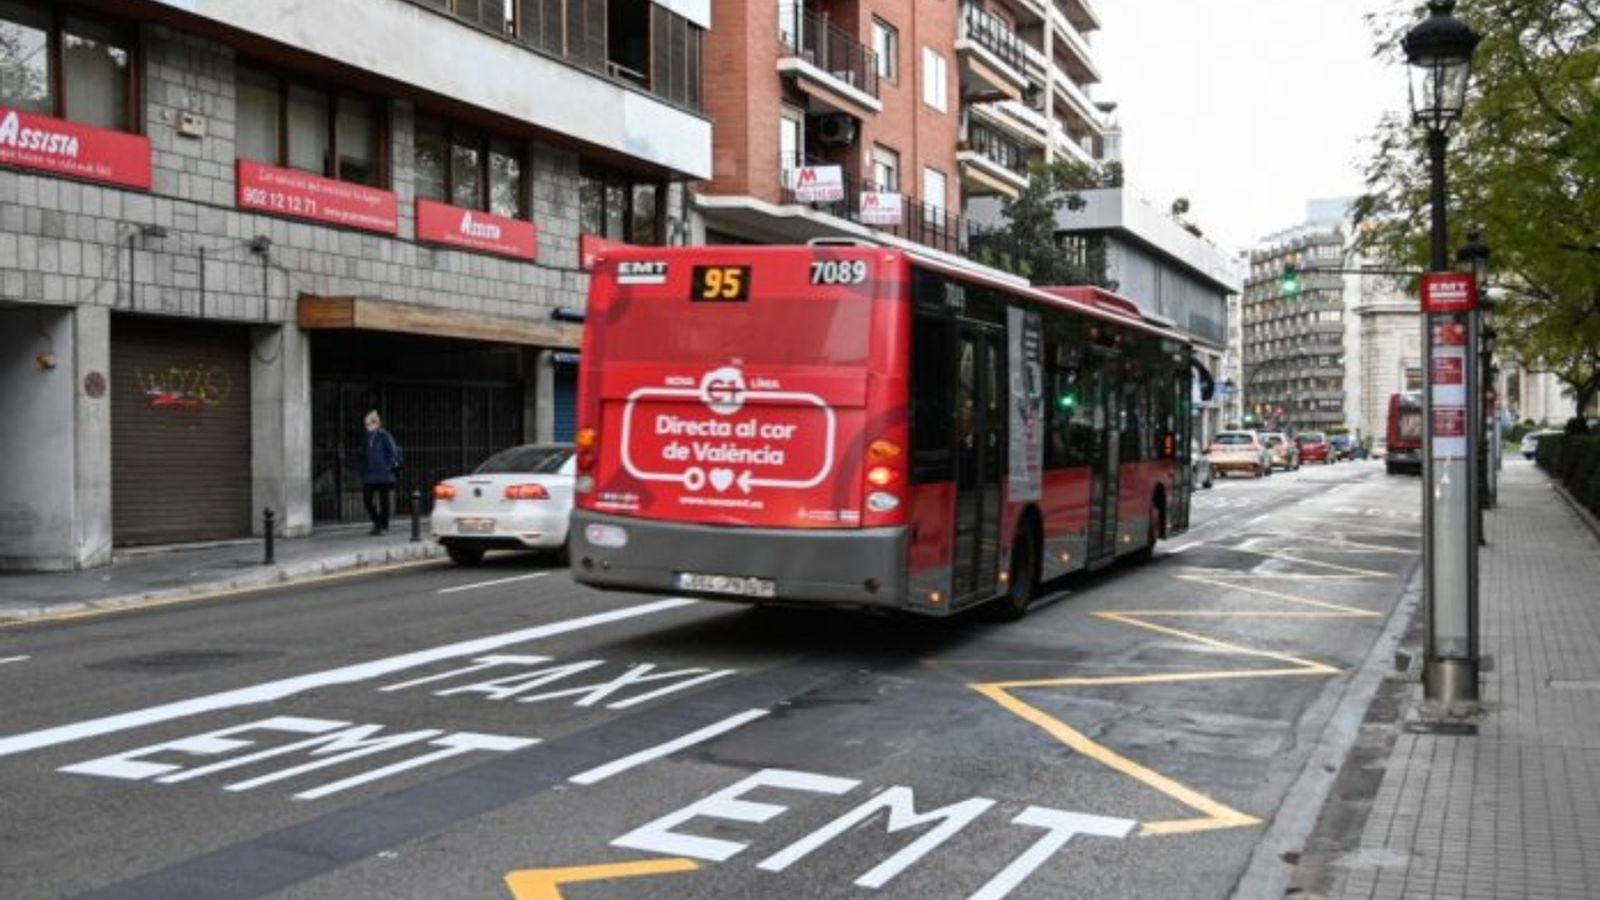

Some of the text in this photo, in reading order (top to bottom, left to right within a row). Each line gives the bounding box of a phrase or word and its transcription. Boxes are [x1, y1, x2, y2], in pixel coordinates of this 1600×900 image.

[243, 186, 316, 215] 902 12 12 71
[617, 262, 668, 273] EMT
[810, 260, 869, 285] 7089
[703, 268, 742, 298] 95
[655, 414, 798, 440] Directa al cor
[662, 441, 785, 466] de València
[377, 654, 737, 711] TAXI
[56, 715, 543, 801] EMT
[608, 768, 1138, 900] EMT
